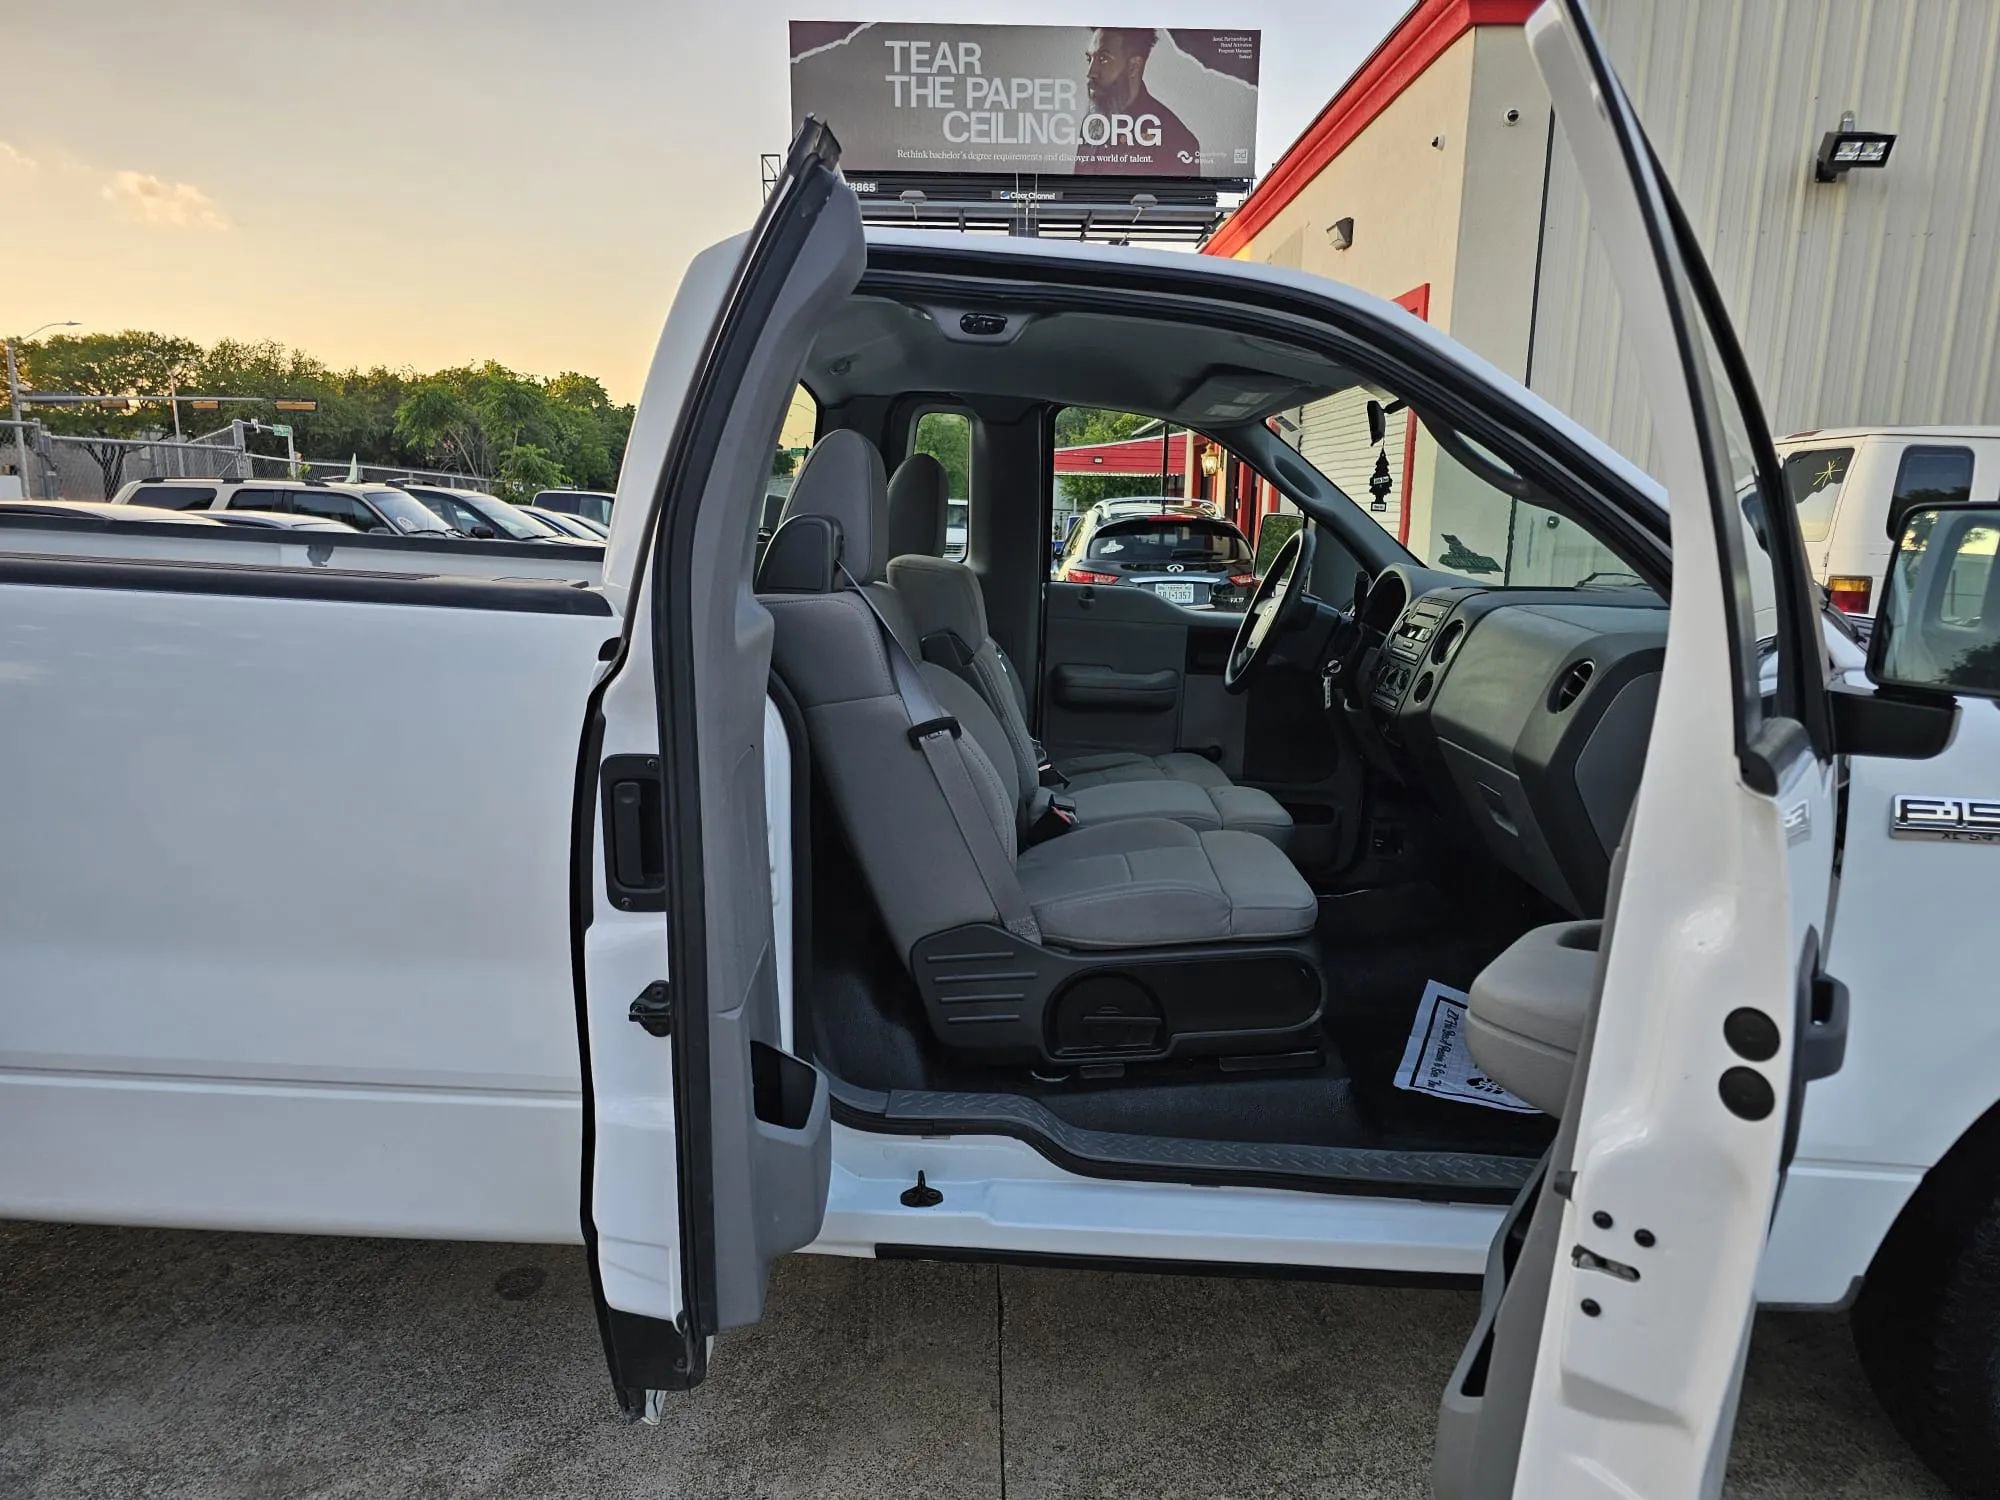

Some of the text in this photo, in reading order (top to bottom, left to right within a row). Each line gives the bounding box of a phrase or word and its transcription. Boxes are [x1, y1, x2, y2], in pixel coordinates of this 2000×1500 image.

[885, 41, 982, 75] TEAR
[885, 75, 1077, 111] THE PAPER
[942, 111, 1162, 147] CEILING.ORG
[897, 149, 928, 158] Rethink
[967, 151, 992, 162] degree
[993, 153, 1042, 162] requirements
[1058, 153, 1090, 163] discover
[1096, 154, 1118, 163] world
[1119, 154, 1129, 163] of
[1129, 154, 1153, 163] talent.
